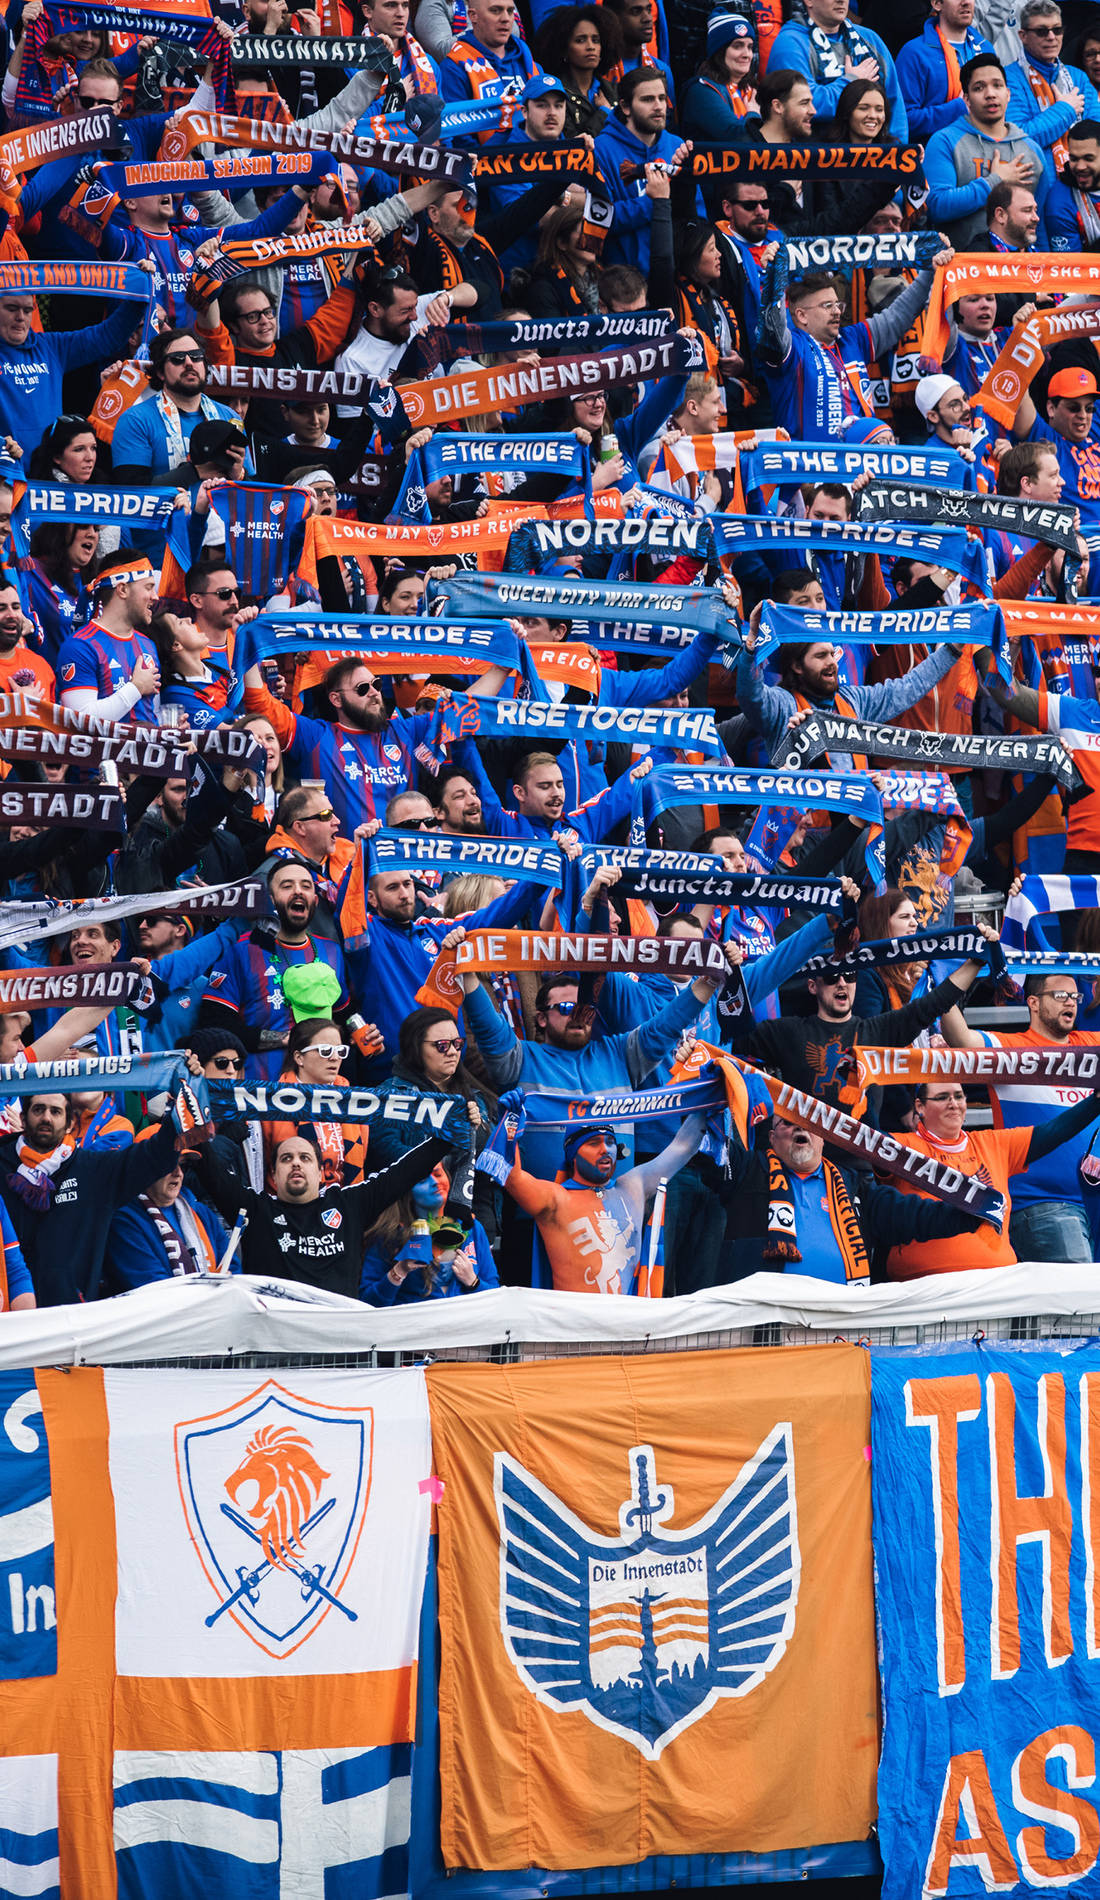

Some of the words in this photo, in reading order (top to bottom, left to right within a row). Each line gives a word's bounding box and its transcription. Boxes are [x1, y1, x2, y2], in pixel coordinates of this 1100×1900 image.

[58, 7, 79, 27] FC
[231, 33, 367, 65] CINCINNATI
[485, 86, 498, 98] FC
[25, 114, 111, 158] INNENSTADT
[187, 114, 240, 139] DIE
[250, 121, 463, 176] INNENSTADT
[125, 157, 210, 186] INAUGURAL
[214, 156, 272, 176] SEASON
[276, 153, 313, 175] 2019
[473, 154, 513, 177] AN
[693, 151, 741, 176] OLD
[749, 149, 812, 172] MAN
[817, 147, 918, 173] ULTRAS
[251, 237, 288, 261] Die
[784, 234, 919, 272] NORDEN
[43, 264, 77, 286] AND
[80, 264, 128, 290] UNITE
[290, 264, 321, 274] MERC
[945, 266, 980, 285] ONG
[985, 265, 1021, 278] MAY
[1049, 265, 1082, 278] SHE
[434, 382, 480, 413] DIE
[487, 342, 675, 402] INNENSTADT
[457, 441, 498, 463] THE
[500, 440, 559, 463] PRIDE
[783, 451, 839, 473] THE
[845, 452, 926, 477] PRIDE
[30, 489, 72, 512] HE
[75, 489, 160, 518] PRIDE
[859, 489, 928, 513] ATCH
[981, 500, 1074, 535] NEVER
[247, 521, 281, 531] MERCY
[247, 530, 284, 540] HEALTH
[332, 524, 379, 540] LONG
[385, 526, 421, 541] MAY
[450, 523, 481, 539] SHE
[536, 518, 703, 552] NORDEN
[754, 520, 811, 538] THE
[821, 522, 918, 549] PRIDE
[497, 583, 554, 604] QUEEN
[558, 586, 601, 607] CITY
[604, 589, 645, 610] WAR
[648, 593, 684, 612] PIGS
[295, 622, 365, 640] THE
[369, 623, 466, 646] PRIDE
[598, 620, 655, 643] THE
[825, 611, 872, 633] THE
[879, 610, 953, 633] PRIDE
[496, 699, 570, 729] RISE
[575, 704, 719, 747] TOGETHE
[824, 720, 911, 748] WATCH
[951, 735, 1029, 759] NEVER
[365, 764, 402, 777] MERCY
[366, 773, 408, 786] HEALTH
[693, 773, 751, 793] THE
[757, 775, 842, 801] PRIDE
[880, 776, 942, 806] RIDE
[398, 837, 456, 861] THE
[459, 841, 543, 869] PRIDE
[595, 847, 641, 868] THE
[456, 935, 508, 966] DIE
[34, 1058, 81, 1079] WAR
[85, 1055, 133, 1076] PIGS
[862, 1049, 910, 1076] DIE
[234, 1086, 455, 1130] NORDEN
[567, 1101, 590, 1120] FC
[590, 1093, 683, 1117] CINCINNATI
[776, 1081, 988, 1204] INNENSTADT
[298, 1232, 336, 1248] MERCY
[298, 1241, 345, 1257] HEALTH
[592, 1563, 617, 1583] Die
